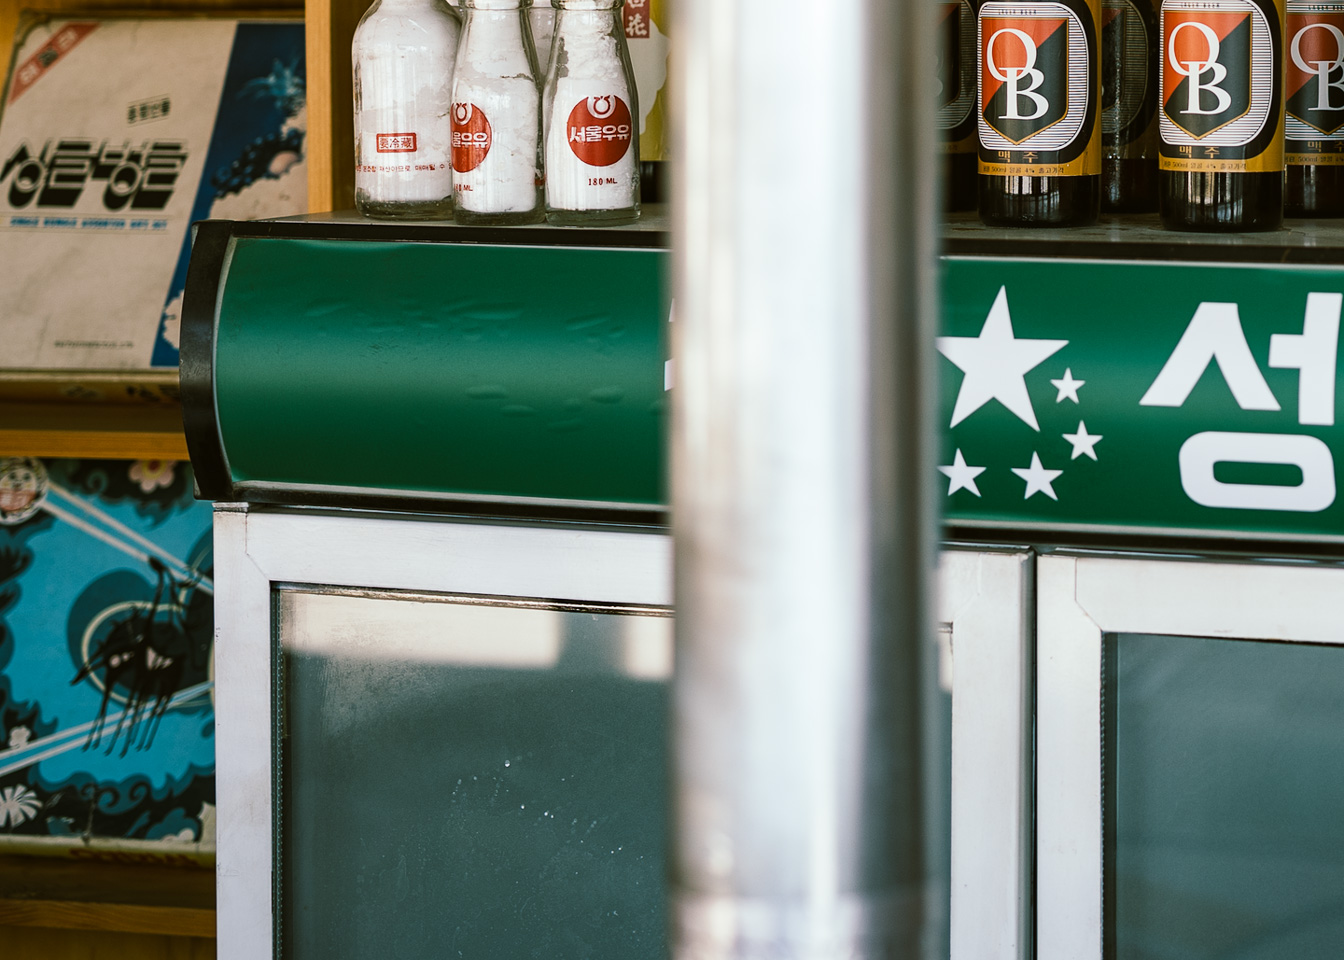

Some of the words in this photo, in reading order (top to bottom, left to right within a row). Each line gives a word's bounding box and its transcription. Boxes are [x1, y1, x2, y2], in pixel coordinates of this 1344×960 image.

[987, 28, 1049, 120] OB
[1168, 21, 1231, 115] OB
[569, 125, 629, 143] 서울우유
[588, 178, 603, 186] 180
[1139, 291, 1343, 513] 성
